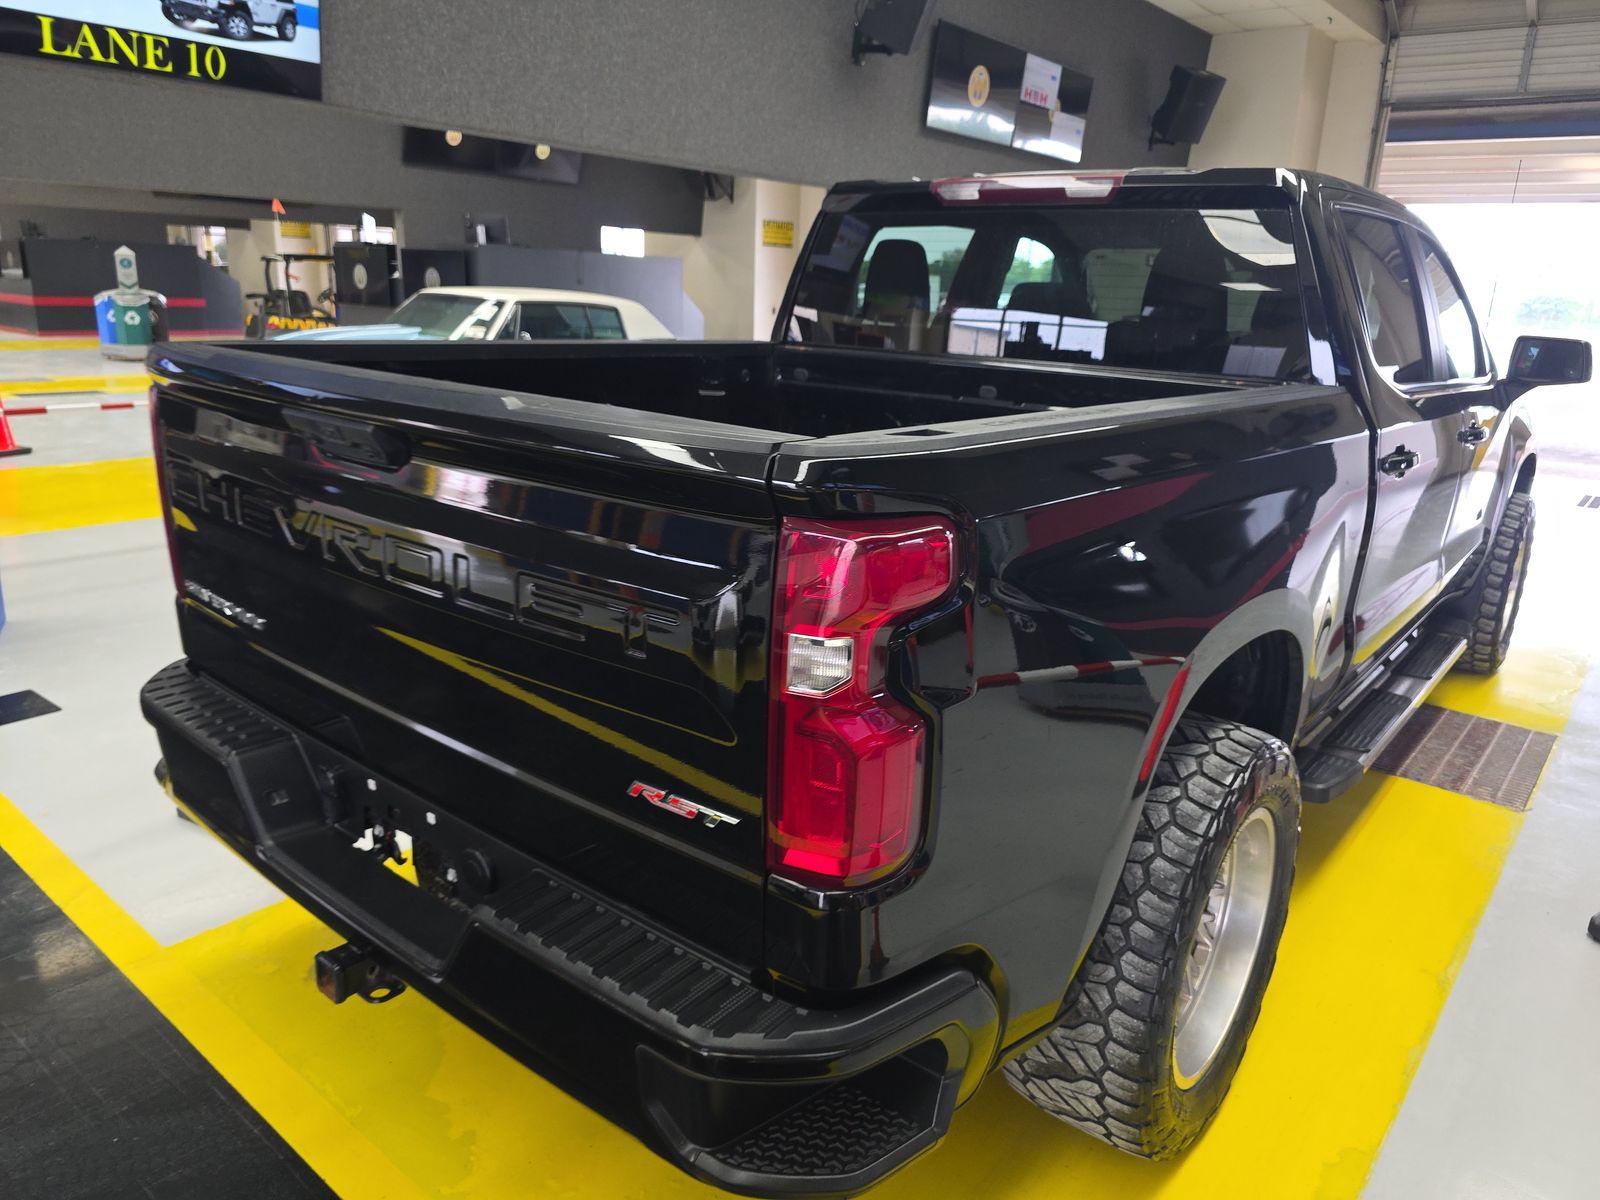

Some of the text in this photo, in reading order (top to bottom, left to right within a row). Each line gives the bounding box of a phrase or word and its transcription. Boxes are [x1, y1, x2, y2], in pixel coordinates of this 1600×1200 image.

[37, 15, 227, 81] LANE 10
[167, 458, 681, 660] CHEVROLET
[626, 780, 742, 829] RST
